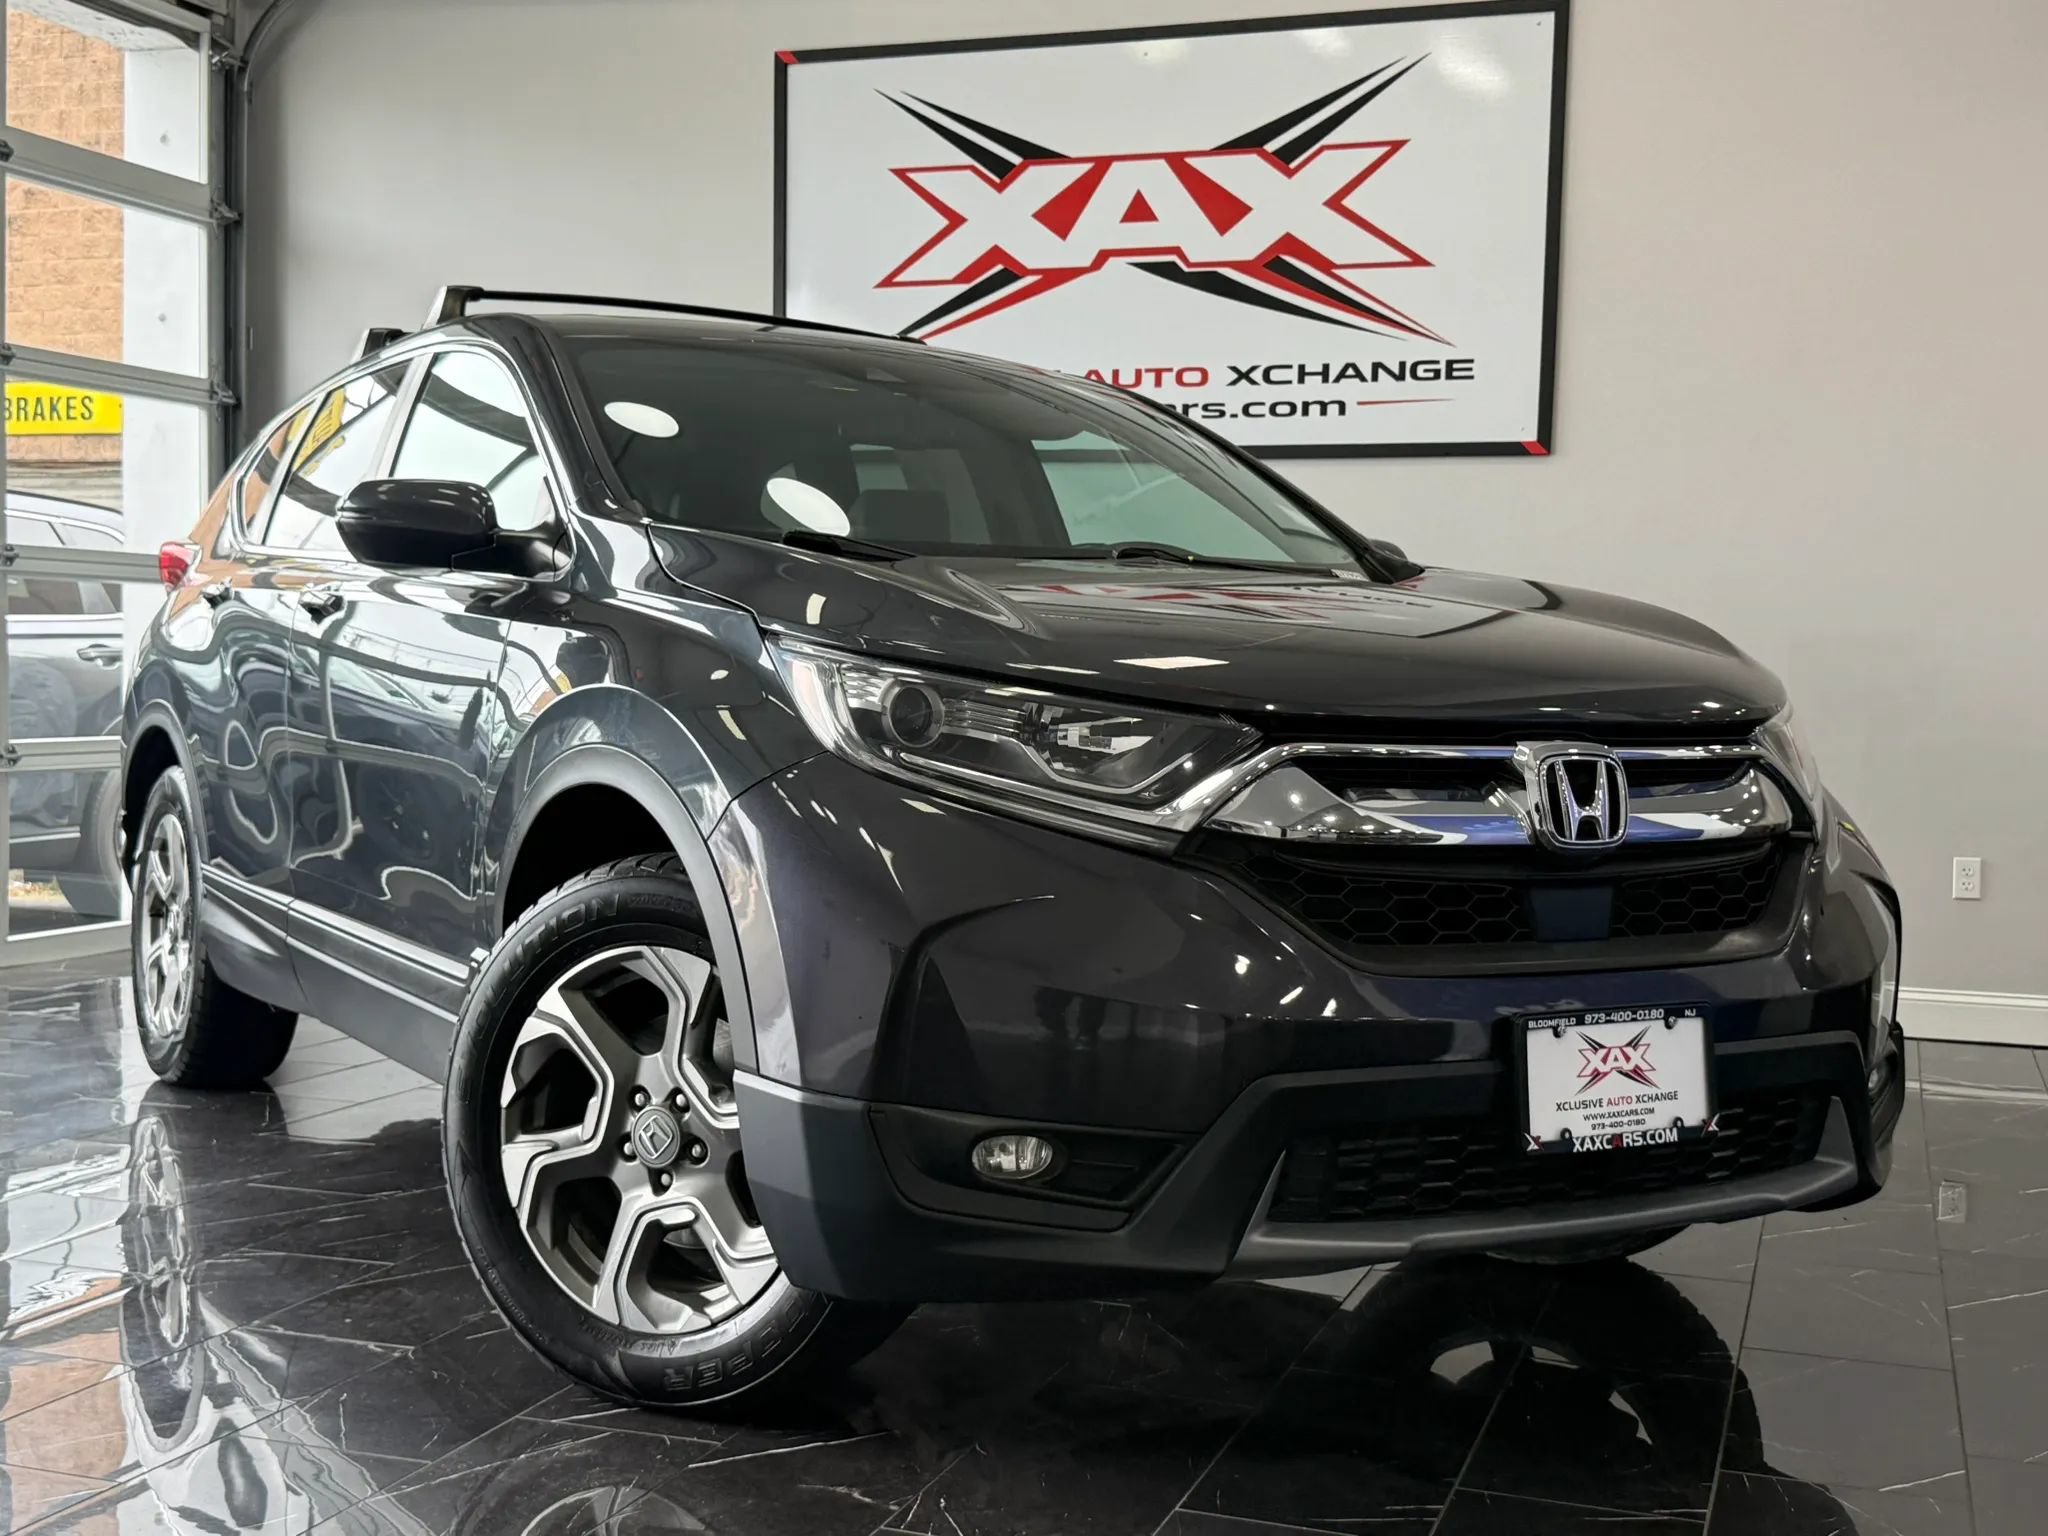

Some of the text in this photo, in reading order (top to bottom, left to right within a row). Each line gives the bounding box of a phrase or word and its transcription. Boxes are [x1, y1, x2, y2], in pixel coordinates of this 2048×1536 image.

[873, 138, 1436, 289] XAX
[1226, 359, 1475, 387] XCHANGE
[1528, 1007, 1697, 1029] BLOOMFIELD 973-400-0180 NJ
[1576, 1042, 1657, 1078] XAX
[1555, 1090, 1680, 1112] XCLUSIVE AUTO XCHANGE
[1582, 1107, 1656, 1121] WWW.XAXCARS.COM
[1591, 1118, 1647, 1131] 973-400-0180
[1572, 1127, 1679, 1153] XAXCARS.COM
